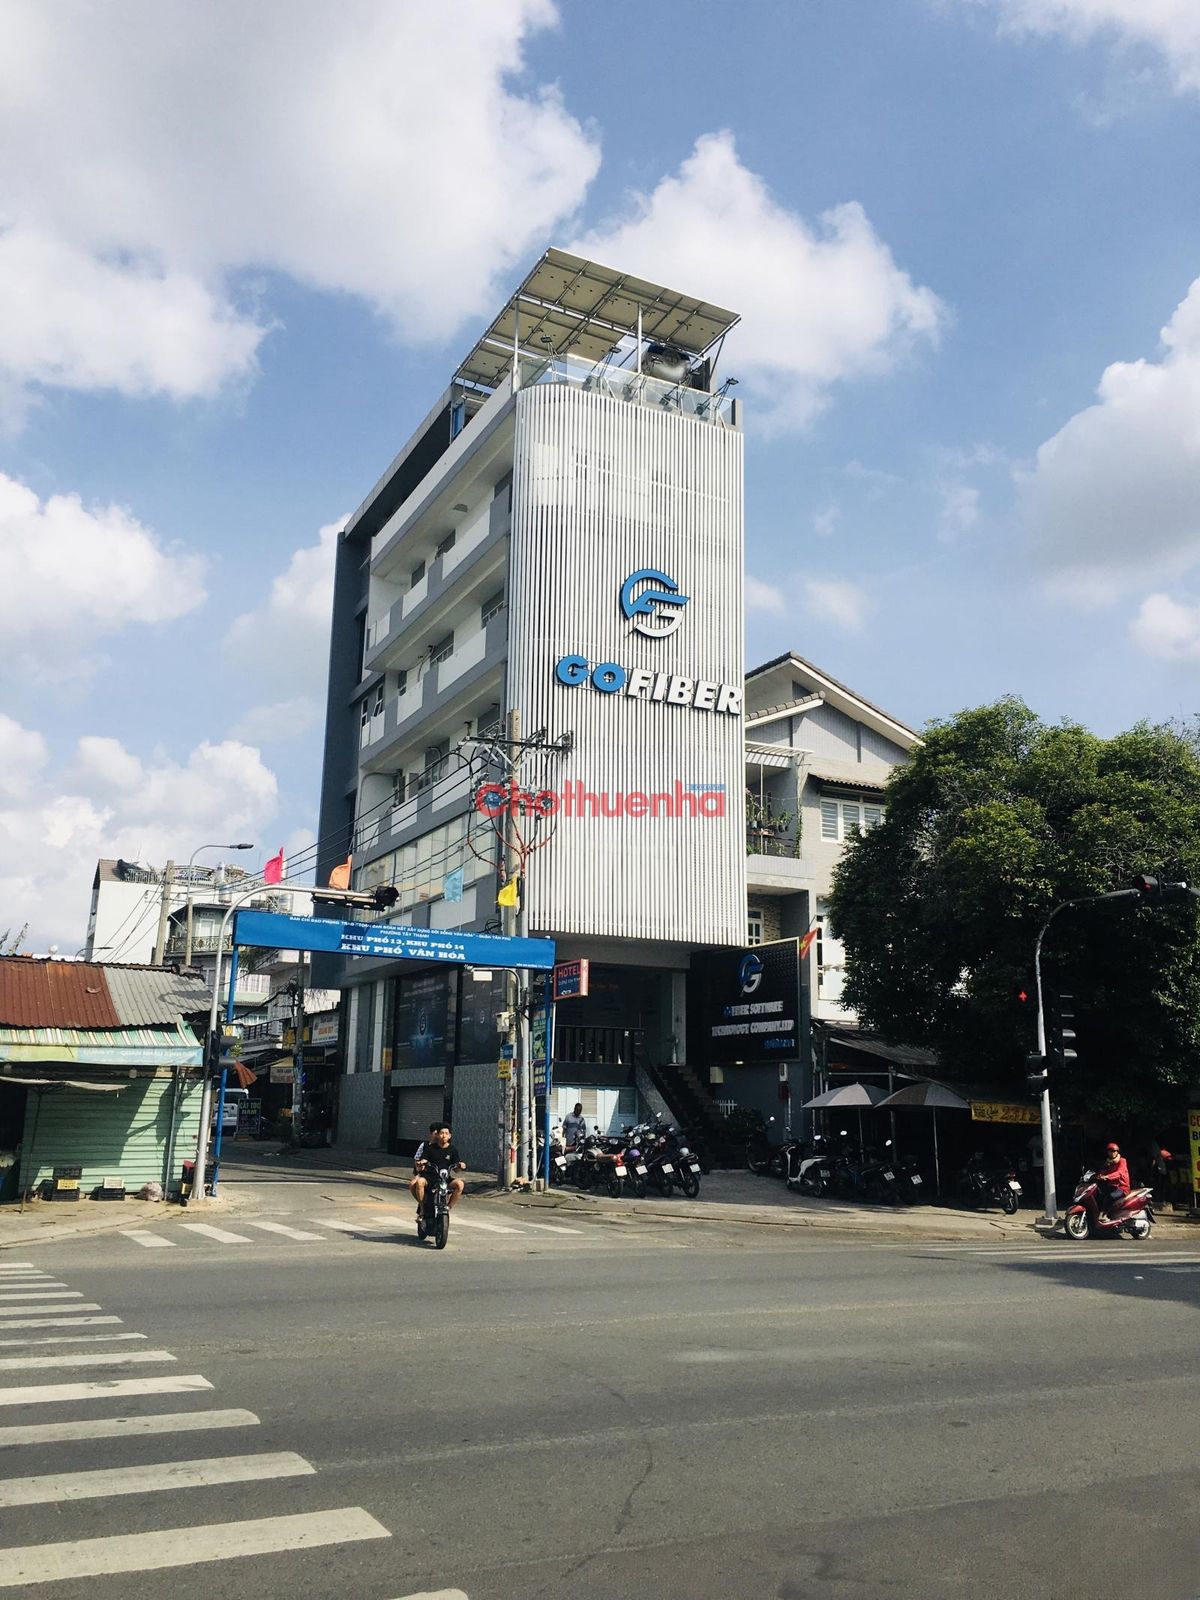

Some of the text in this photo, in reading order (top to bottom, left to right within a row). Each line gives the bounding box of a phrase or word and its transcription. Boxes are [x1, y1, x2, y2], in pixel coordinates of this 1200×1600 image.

[556, 654, 743, 715] GOFIBER
[341, 943, 370, 952] KHU
[408, 948, 434, 957] VĂN
[438, 950, 466, 960] HÓA
[558, 964, 582, 978] HOTEL
